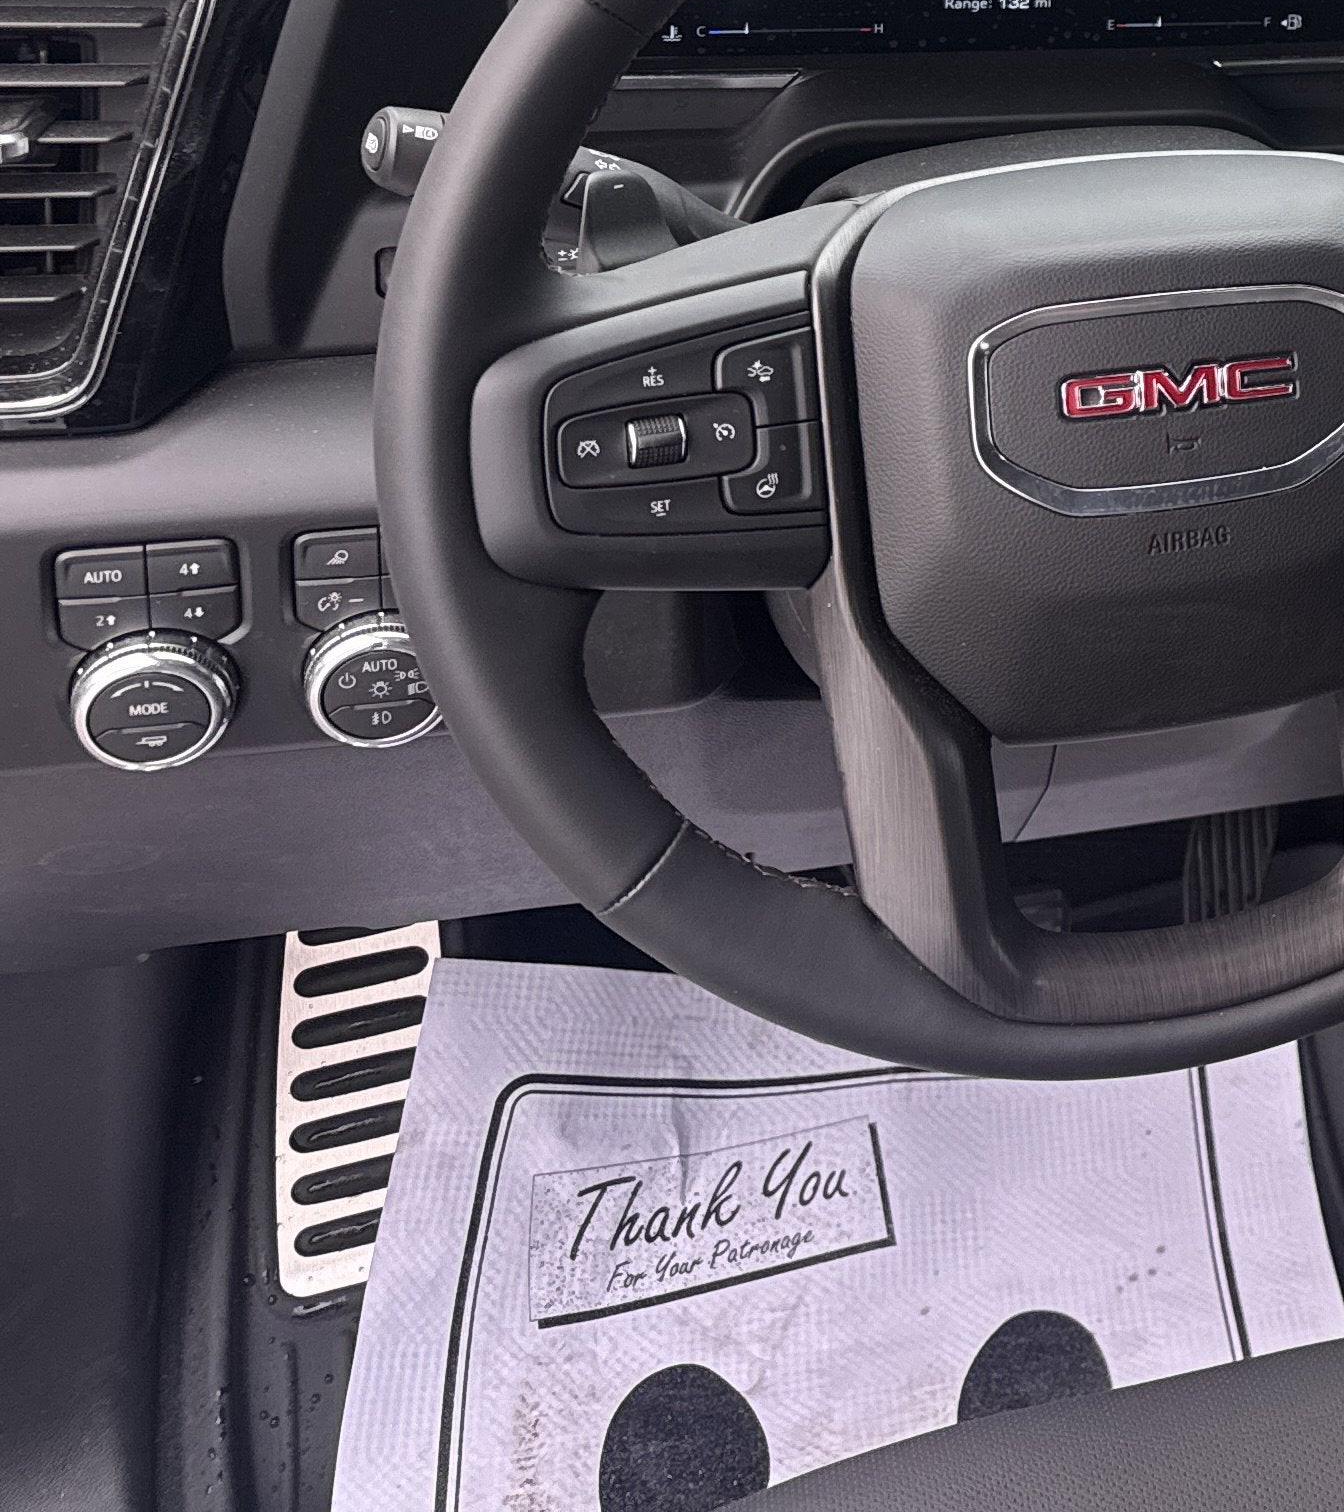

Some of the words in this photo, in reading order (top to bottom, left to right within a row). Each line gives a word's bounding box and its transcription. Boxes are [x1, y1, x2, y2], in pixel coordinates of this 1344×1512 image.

[1106, 19, 1116, 31] E
[1263, 17, 1272, 27] F
[696, 26, 707, 38] C
[873, 24, 885, 34] H
[642, 375, 665, 388] RES
[1060, 355, 1293, 417] GMC
[650, 499, 671, 513] SET
[1147, 525, 1231, 555] AIRBAG
[179, 563, 189, 576] 4
[84, 570, 122, 585] AUTO
[184, 607, 193, 619] 4
[96, 615, 105, 627] 2
[361, 658, 398, 672] AUTO
[128, 702, 169, 716] MODE
[569, 1159, 743, 1261] Thank
[763, 1139, 850, 1220] You
[606, 1261, 646, 1292] For
[655, 1254, 703, 1283] Your
[707, 1228, 815, 1271] Patronage
